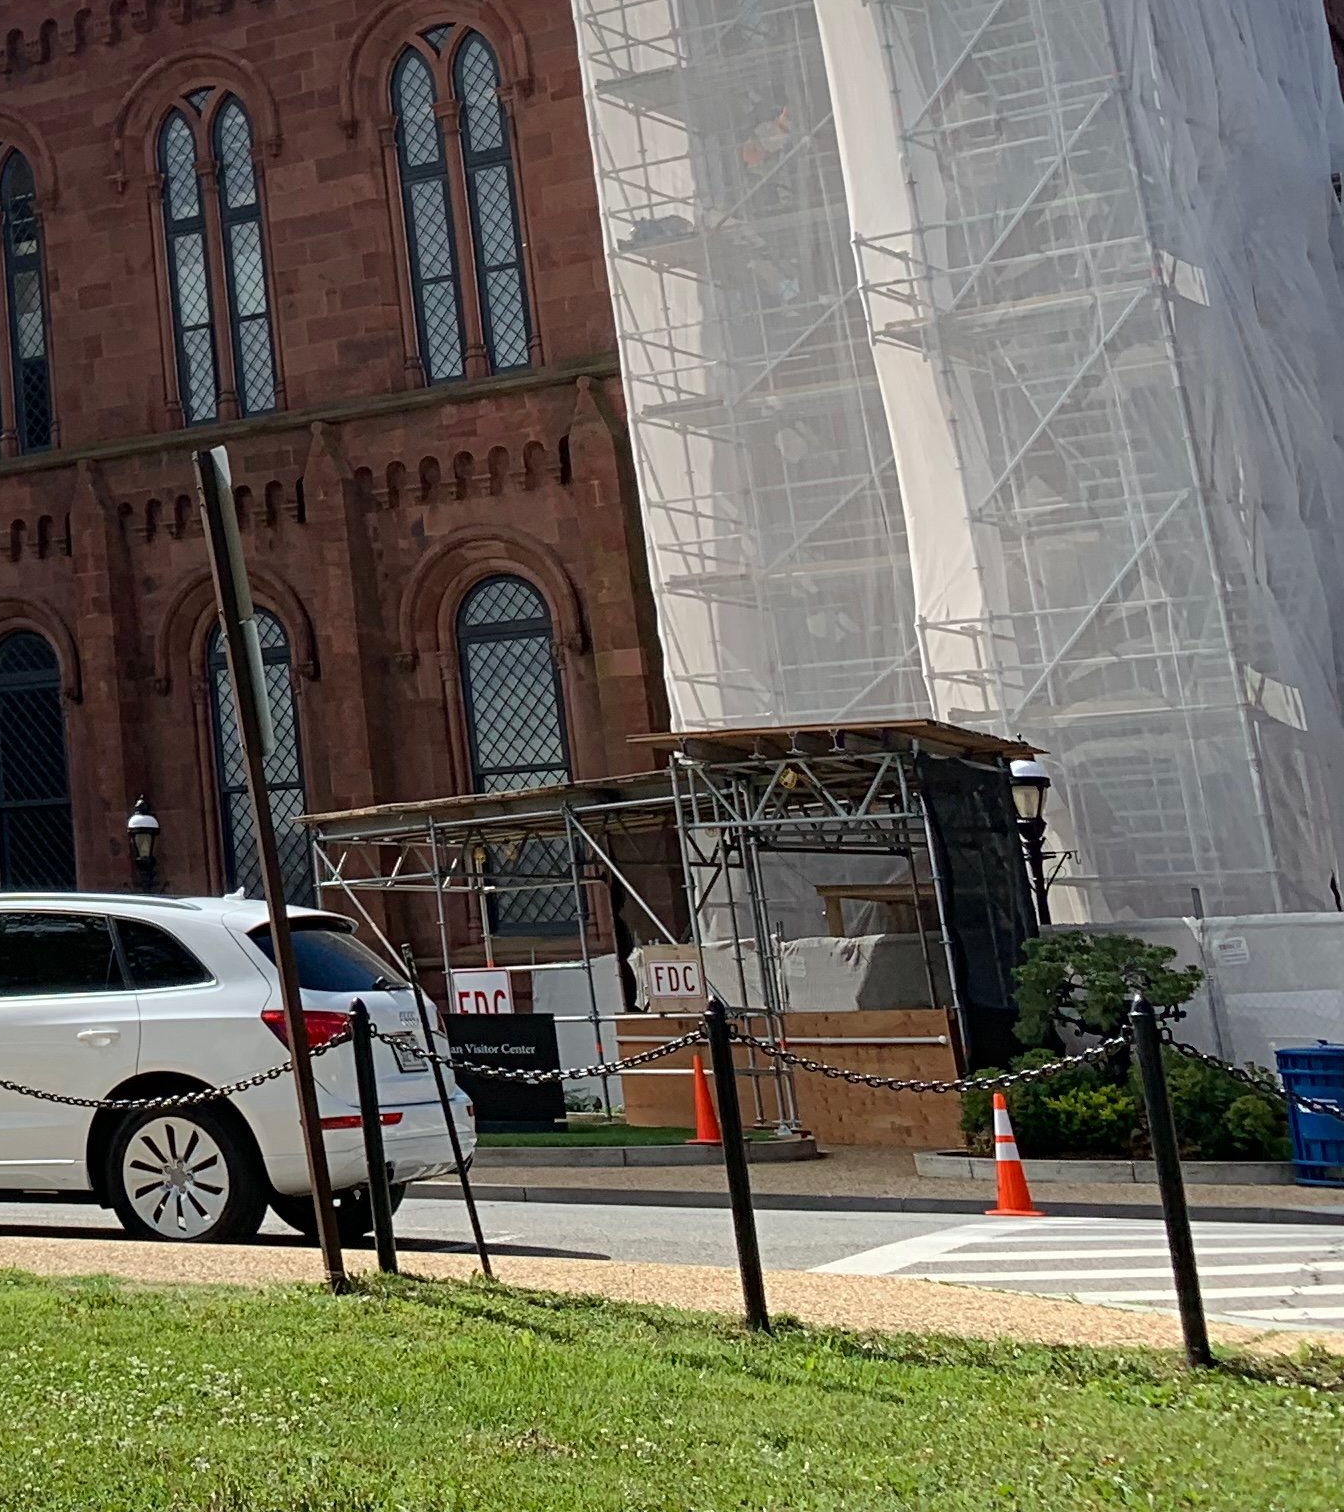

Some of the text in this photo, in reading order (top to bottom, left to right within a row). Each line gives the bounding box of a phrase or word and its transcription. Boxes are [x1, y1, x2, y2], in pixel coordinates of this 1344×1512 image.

[654, 966, 695, 992] FDC
[465, 1043, 499, 1054] Visitor
[501, 1043, 536, 1054] Center
